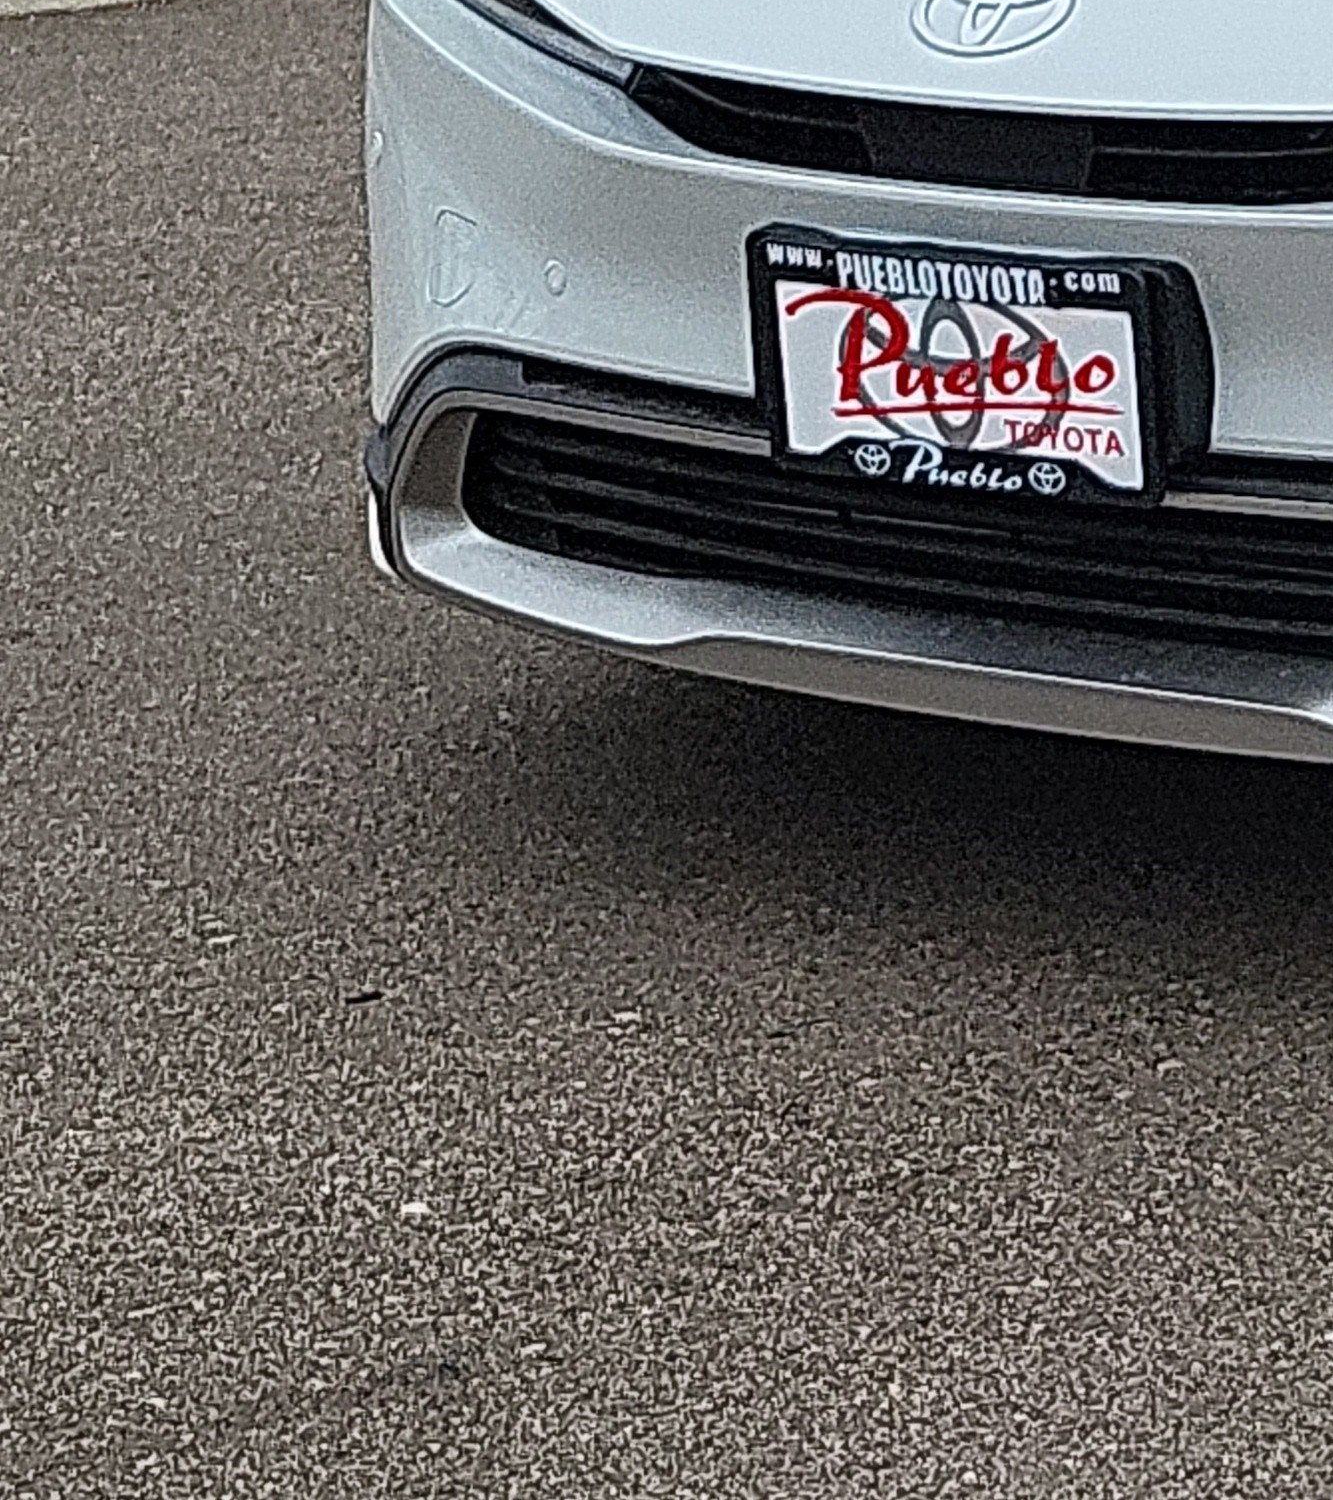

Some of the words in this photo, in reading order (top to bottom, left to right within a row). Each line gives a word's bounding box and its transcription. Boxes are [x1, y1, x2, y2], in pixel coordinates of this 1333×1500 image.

[785, 289, 1115, 400] Pueblo
[1004, 419, 1125, 457] TOYOTA
[889, 440, 1022, 491] Pueblo
